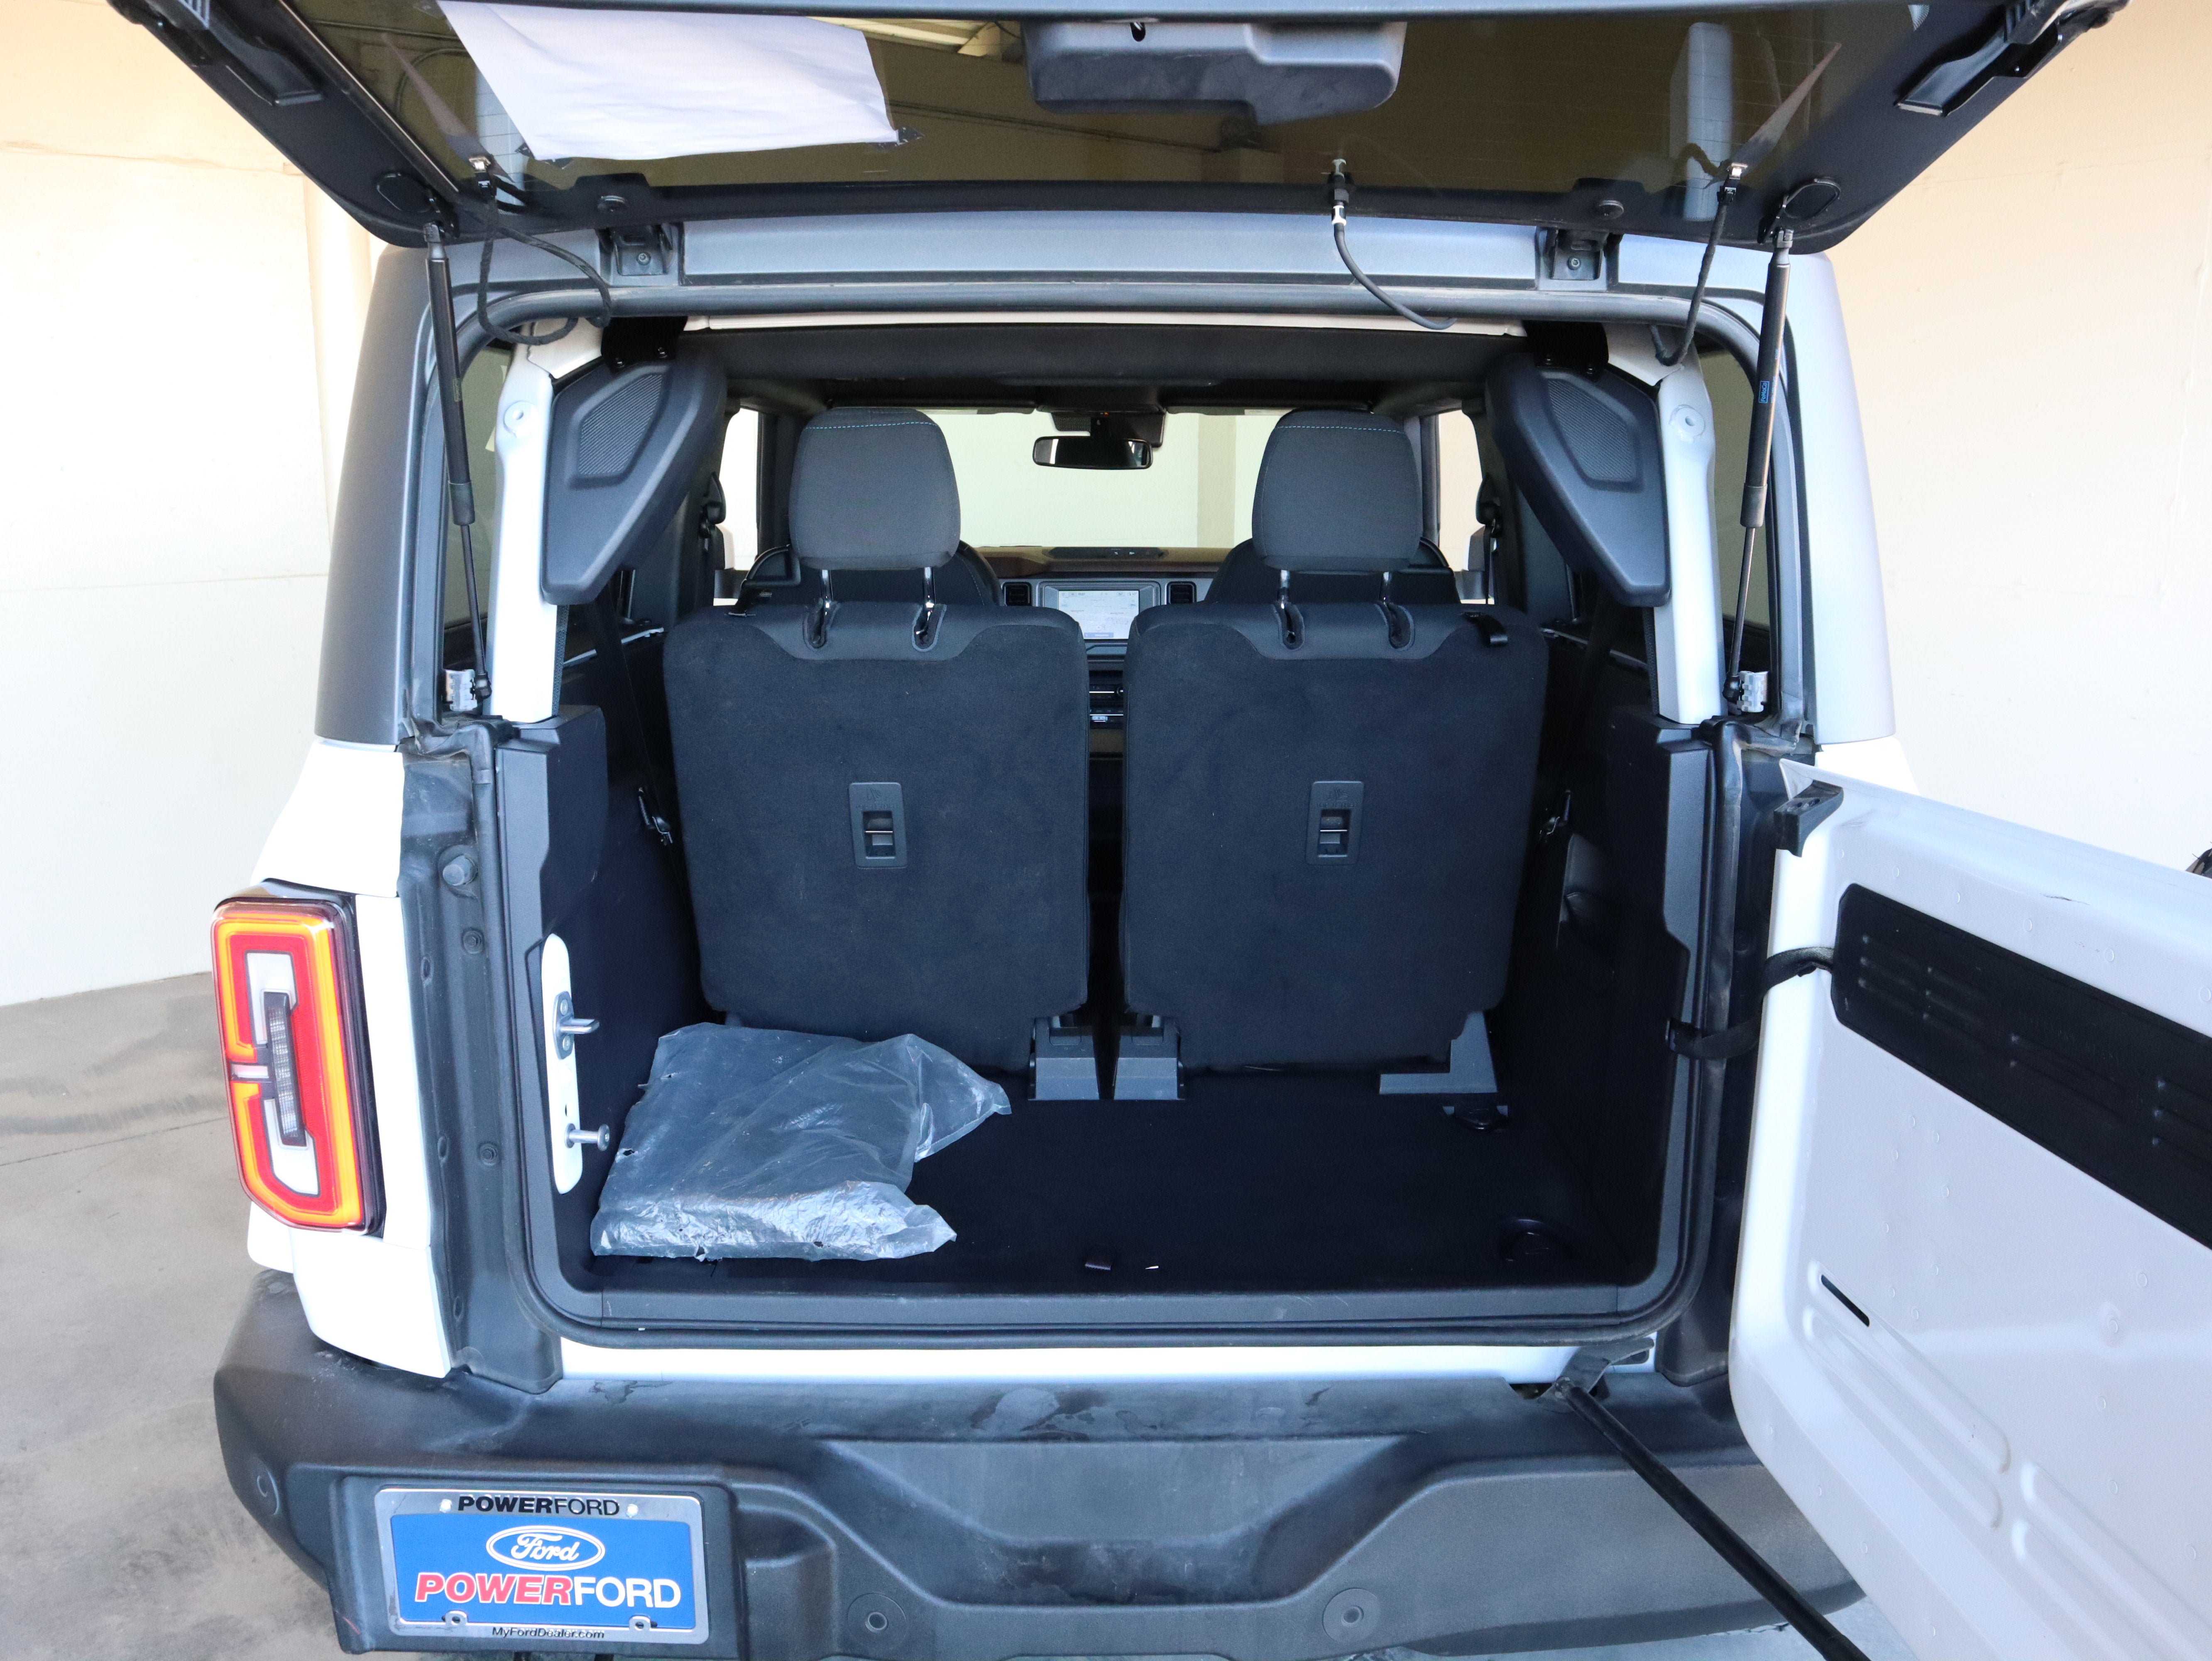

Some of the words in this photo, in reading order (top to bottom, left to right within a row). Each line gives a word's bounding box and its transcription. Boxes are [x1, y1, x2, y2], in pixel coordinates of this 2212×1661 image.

[458, 1495, 620, 1515] POWERFORD
[511, 1533, 580, 1561] Ford
[414, 1571, 681, 1609] POWERFORD
[492, 1627, 605, 1639] MyFordDealer.com
